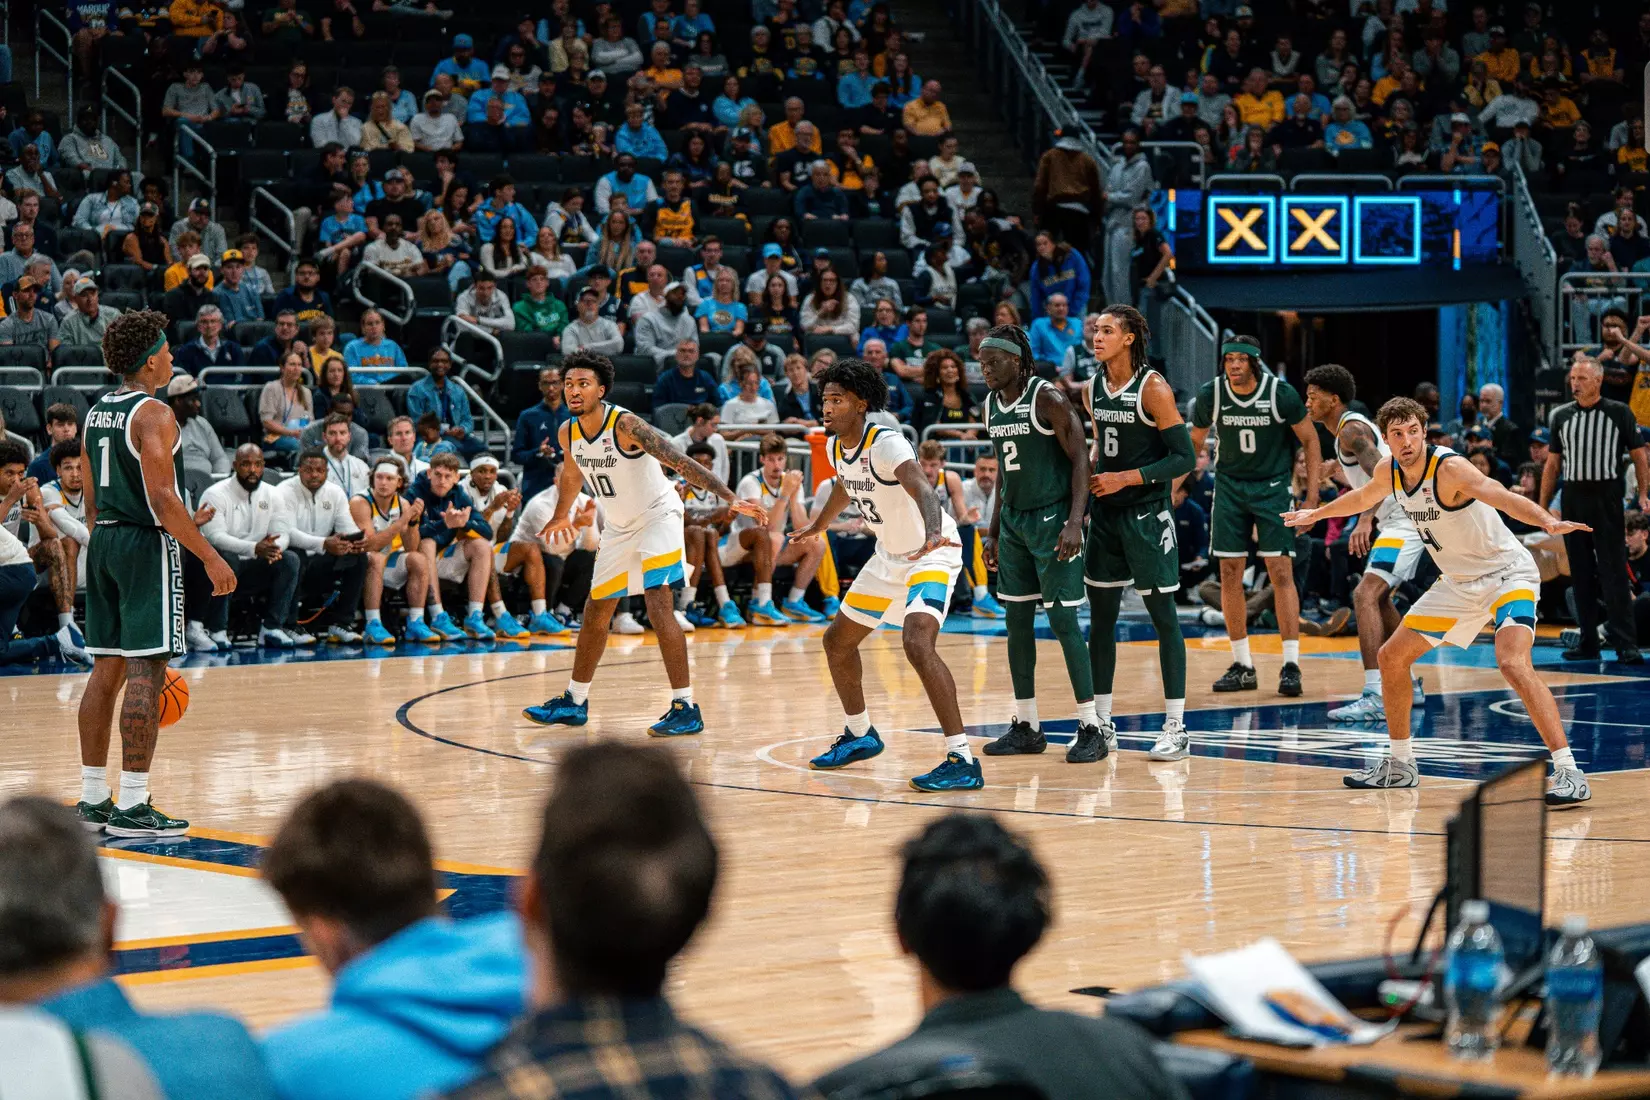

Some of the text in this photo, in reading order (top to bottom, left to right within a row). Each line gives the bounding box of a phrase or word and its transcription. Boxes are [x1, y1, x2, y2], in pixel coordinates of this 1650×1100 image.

[1217, 208, 1341, 250] X X
[1093, 408, 1136, 424] SPARTANS
[1222, 415, 1271, 427] SPARTANS
[989, 422, 1031, 438] SPARTANS
[1104, 426, 1119, 457] 6
[1239, 429, 1257, 454] 0
[98, 436, 110, 487] 1
[574, 454, 618, 471] Marquette
[1002, 441, 1021, 471] 2
[589, 472, 617, 499] 10
[1416, 527, 1443, 552] 4
